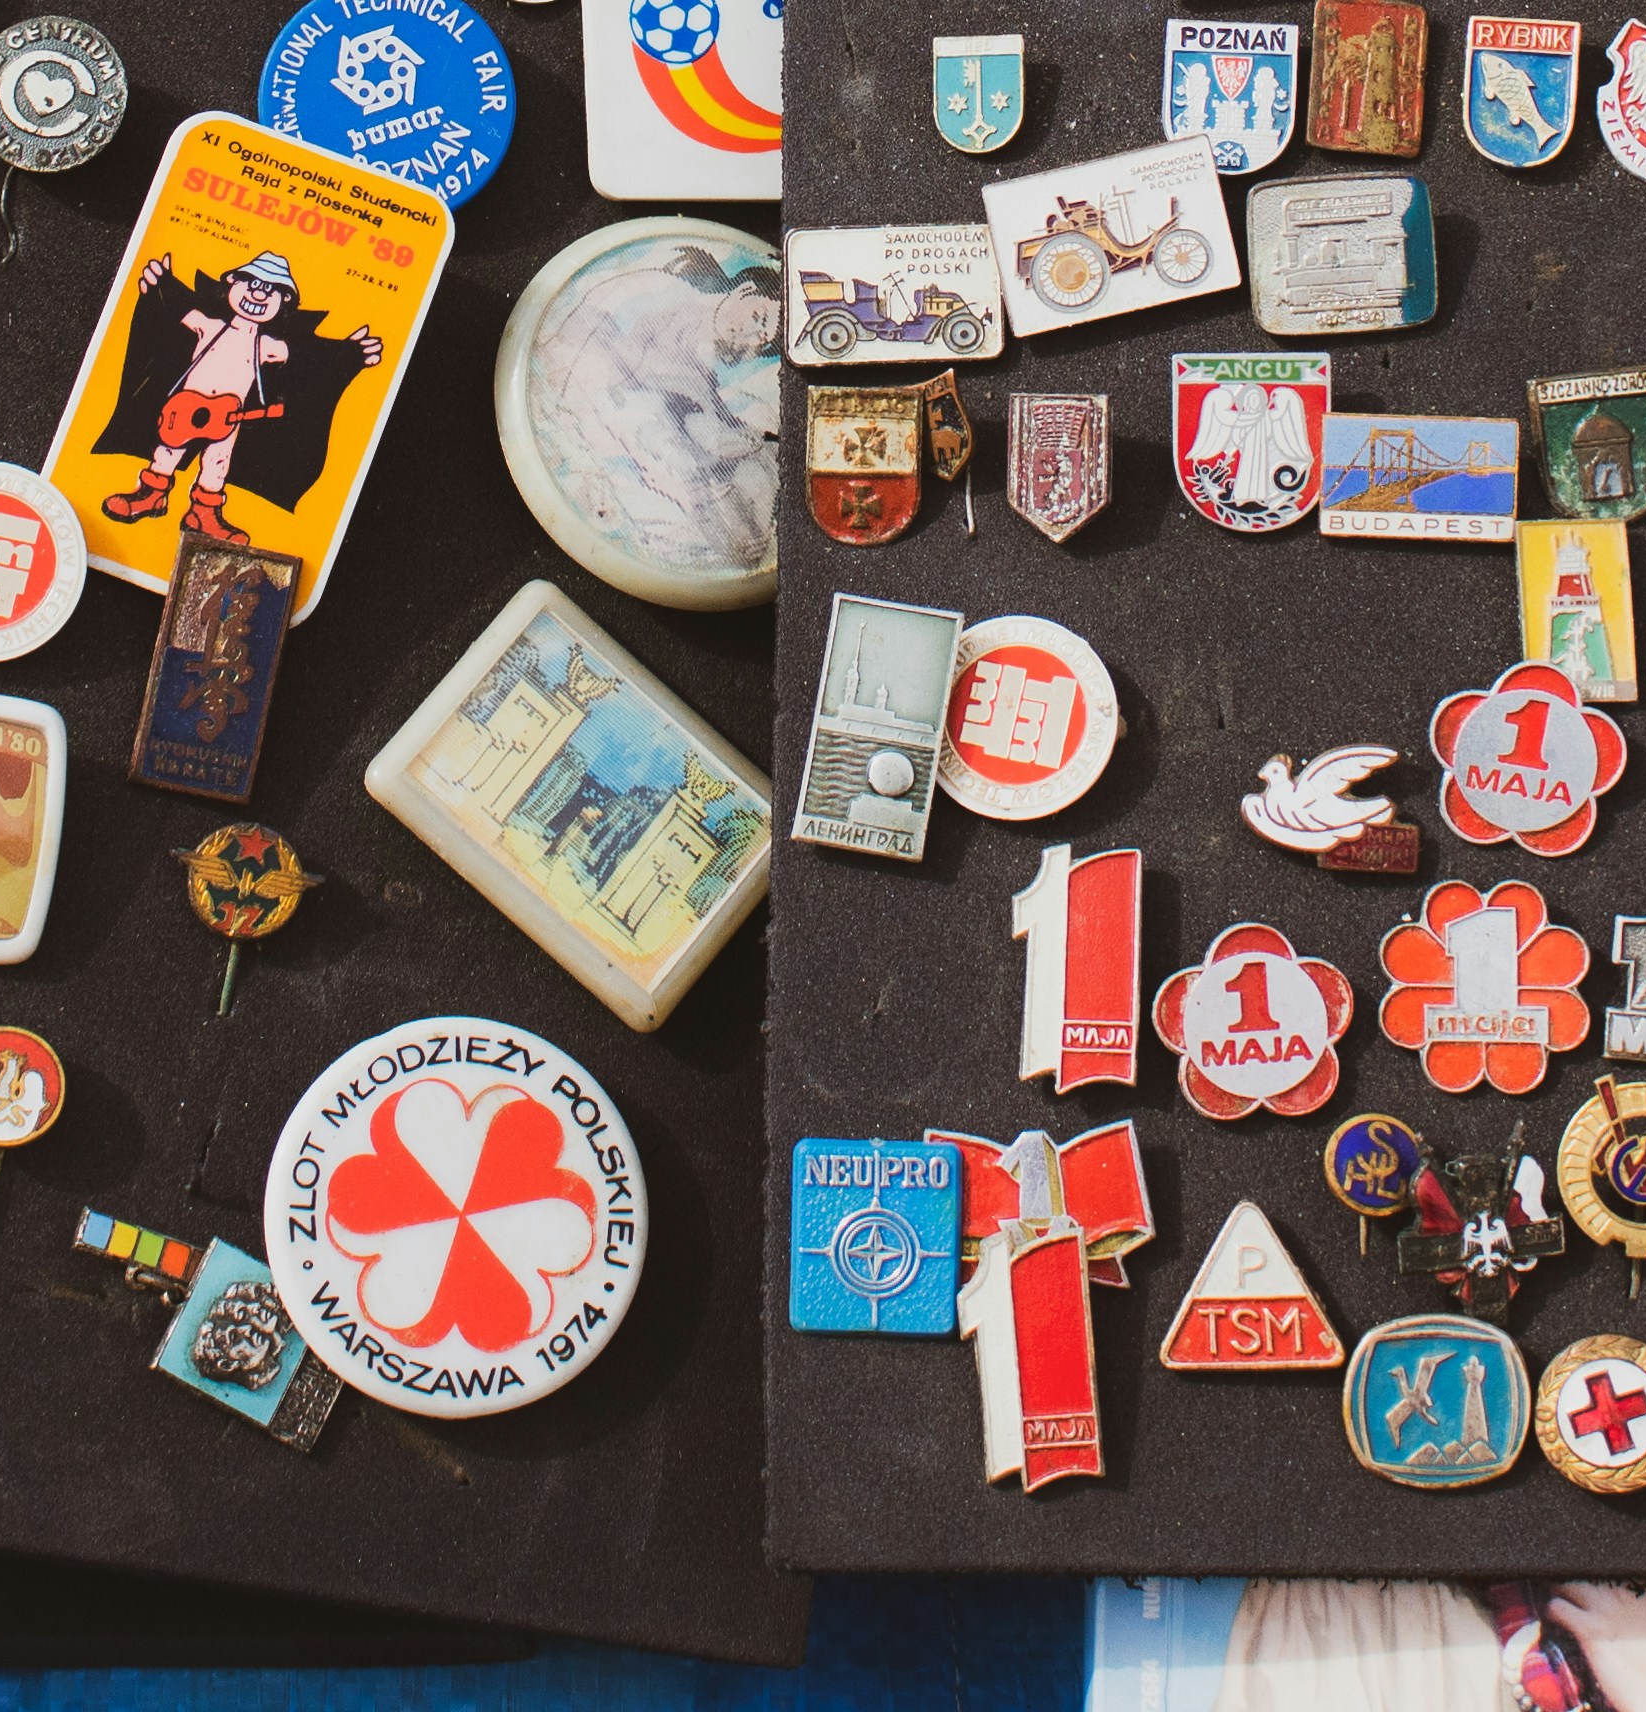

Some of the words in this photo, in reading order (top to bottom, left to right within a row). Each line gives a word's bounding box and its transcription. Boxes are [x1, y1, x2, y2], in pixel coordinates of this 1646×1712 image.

[1180, 25, 1287, 51] POZNAŃ
[1476, 23, 1570, 51] RYBNIK
[472, 50, 508, 115] FAIR
[347, 105, 445, 152] bumar
[201, 130, 221, 147] XI
[227, 139, 346, 192] Ogólnopolski
[350, 184, 439, 228] Studencki
[182, 166, 359, 251] SULEJÓW
[884, 232, 987, 246] SAMOCHODEM
[885, 248, 903, 260] PO
[907, 246, 989, 260] DROGACH
[907, 262, 971, 275] POLSKI
[1196, 358, 1315, 381] ŁAŃCUT
[1327, 515, 1507, 535] BUDAPEST
[1497, 699, 1551, 773] 1
[1466, 764, 1573, 807] MAJA
[802, 818, 916, 854] ЛЕНИНГРАД
[1224, 961, 1281, 1034] 1
[1436, 1012, 1537, 1038] maja
[1201, 1035, 1315, 1068] MAJA
[288, 1132, 331, 1243] ZLOT
[320, 1035, 548, 1129] MŁODZIEŻY
[551, 1073, 636, 1270] POLSKIEJ
[803, 1154, 951, 1189] NEUPRO
[310, 1280, 526, 1399] WARSZAWA
[534, 1301, 610, 1373] 1974
[1199, 1306, 1304, 1355] TSM
